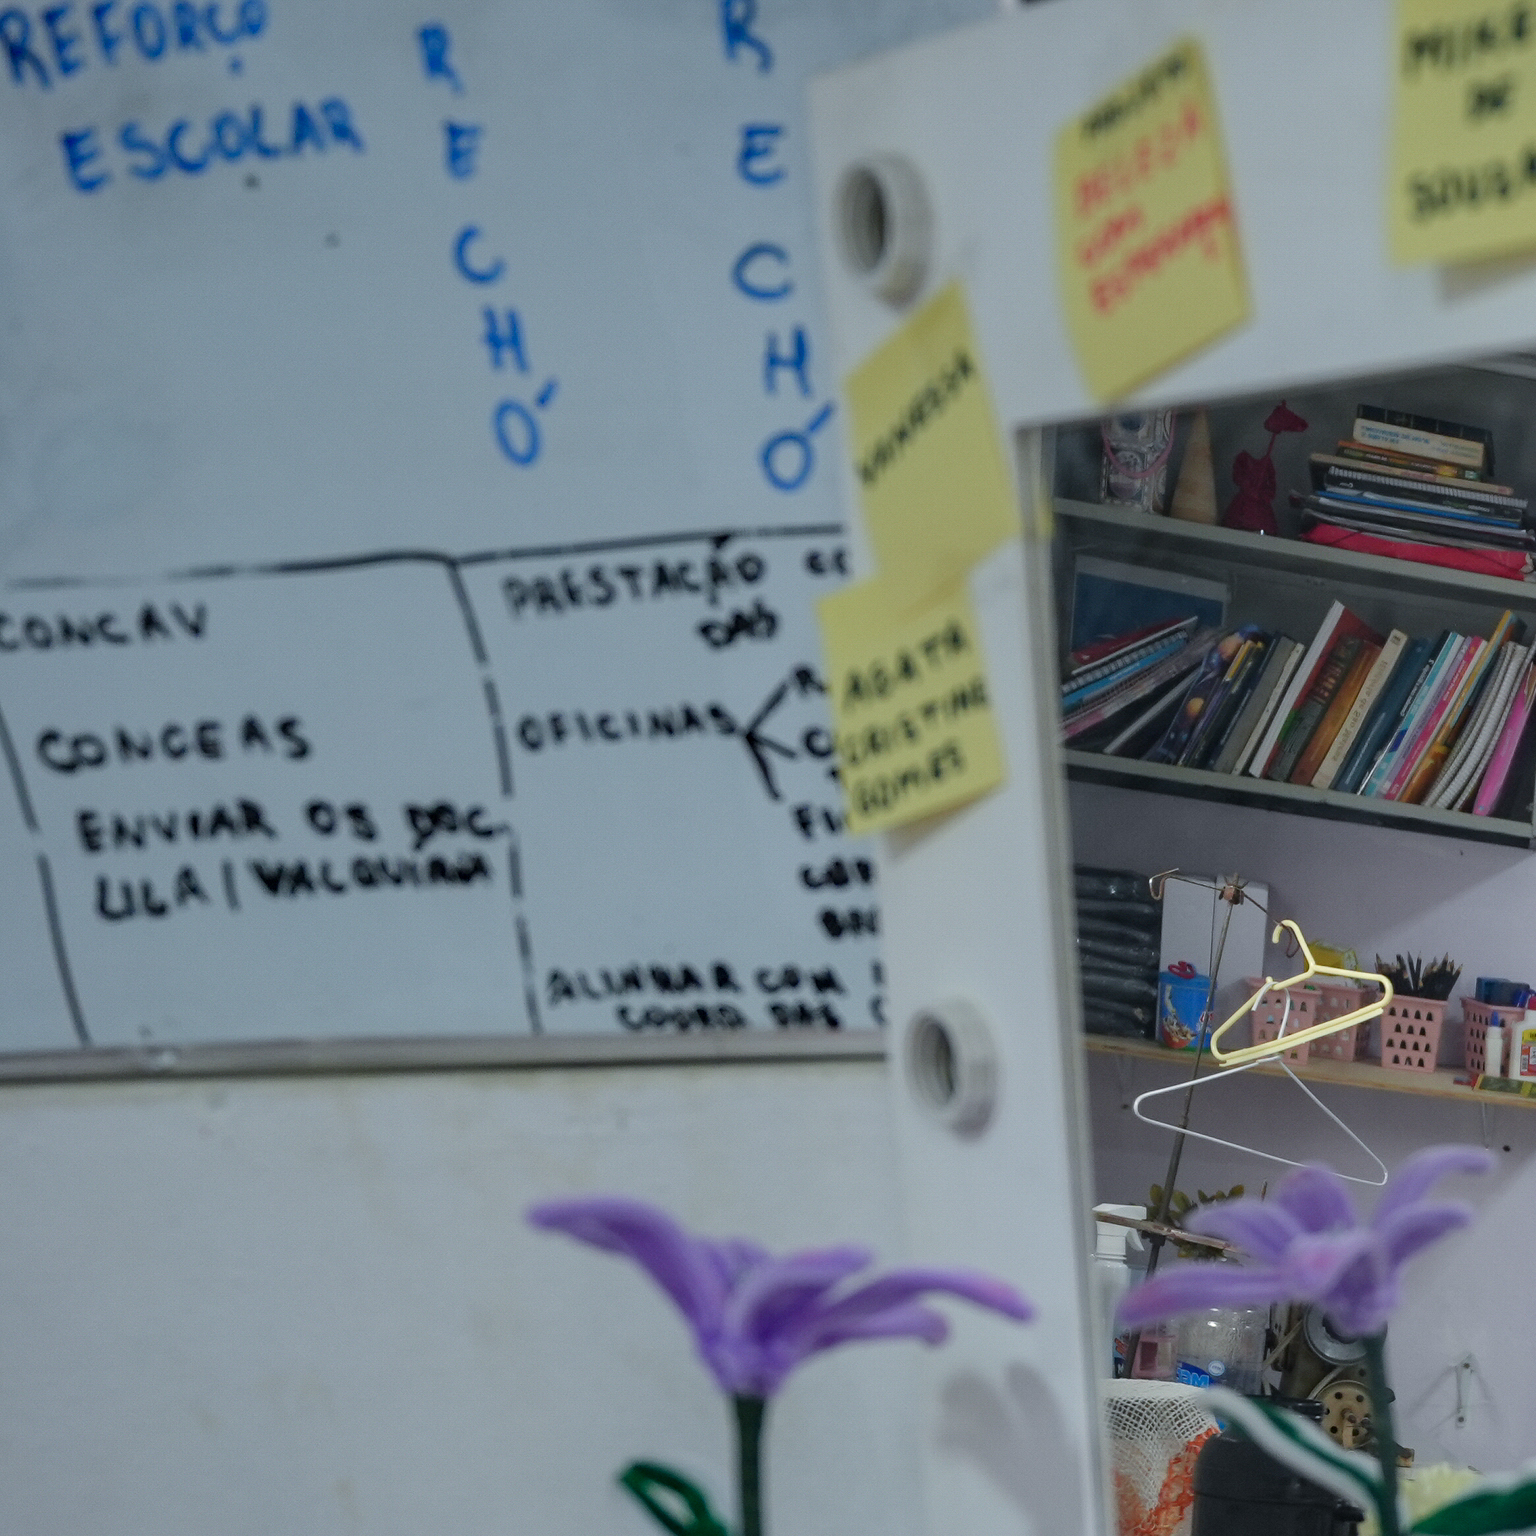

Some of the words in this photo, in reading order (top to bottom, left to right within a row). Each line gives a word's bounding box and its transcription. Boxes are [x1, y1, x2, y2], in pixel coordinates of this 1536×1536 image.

[59, 94, 364, 193] ESCOLAR
[517, 704, 737, 752] OFICINAS
[77, 798, 276, 854] ENVIAR
